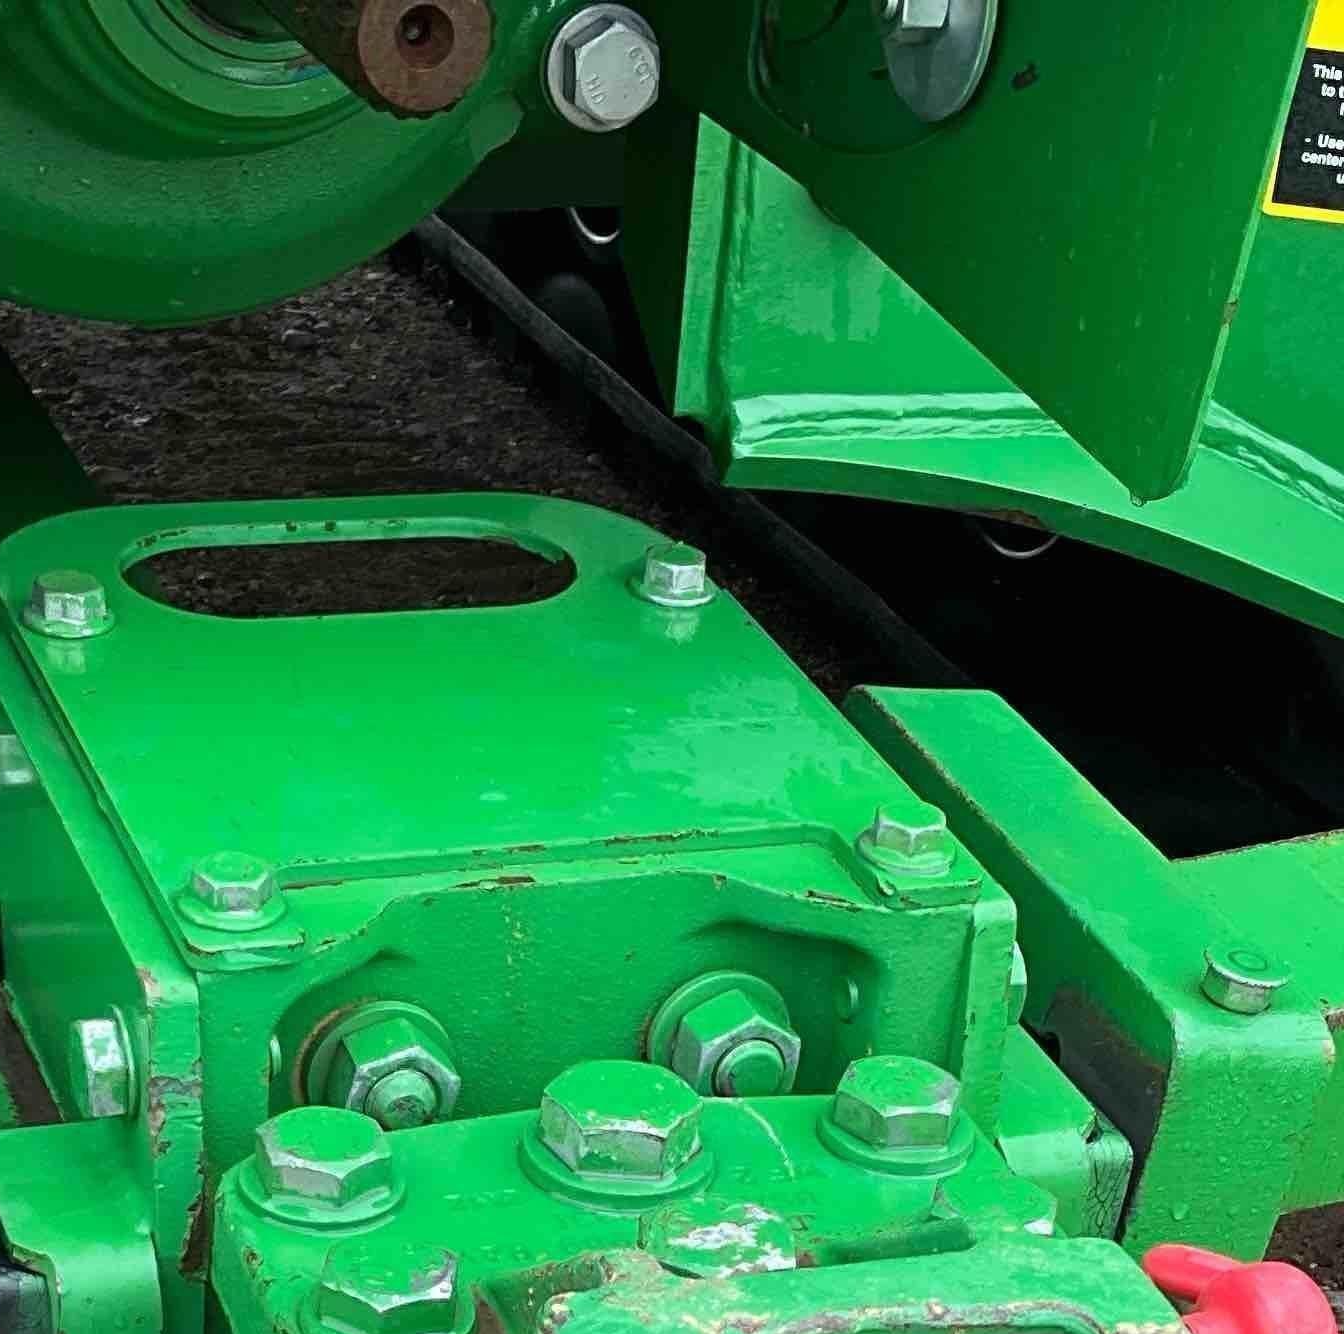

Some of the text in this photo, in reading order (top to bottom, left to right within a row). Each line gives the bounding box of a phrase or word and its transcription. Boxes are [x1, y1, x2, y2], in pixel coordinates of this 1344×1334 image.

[1313, 64, 1343, 81] This
[1321, 83, 1335, 97] to
[1318, 134, 1344, 150] Use
